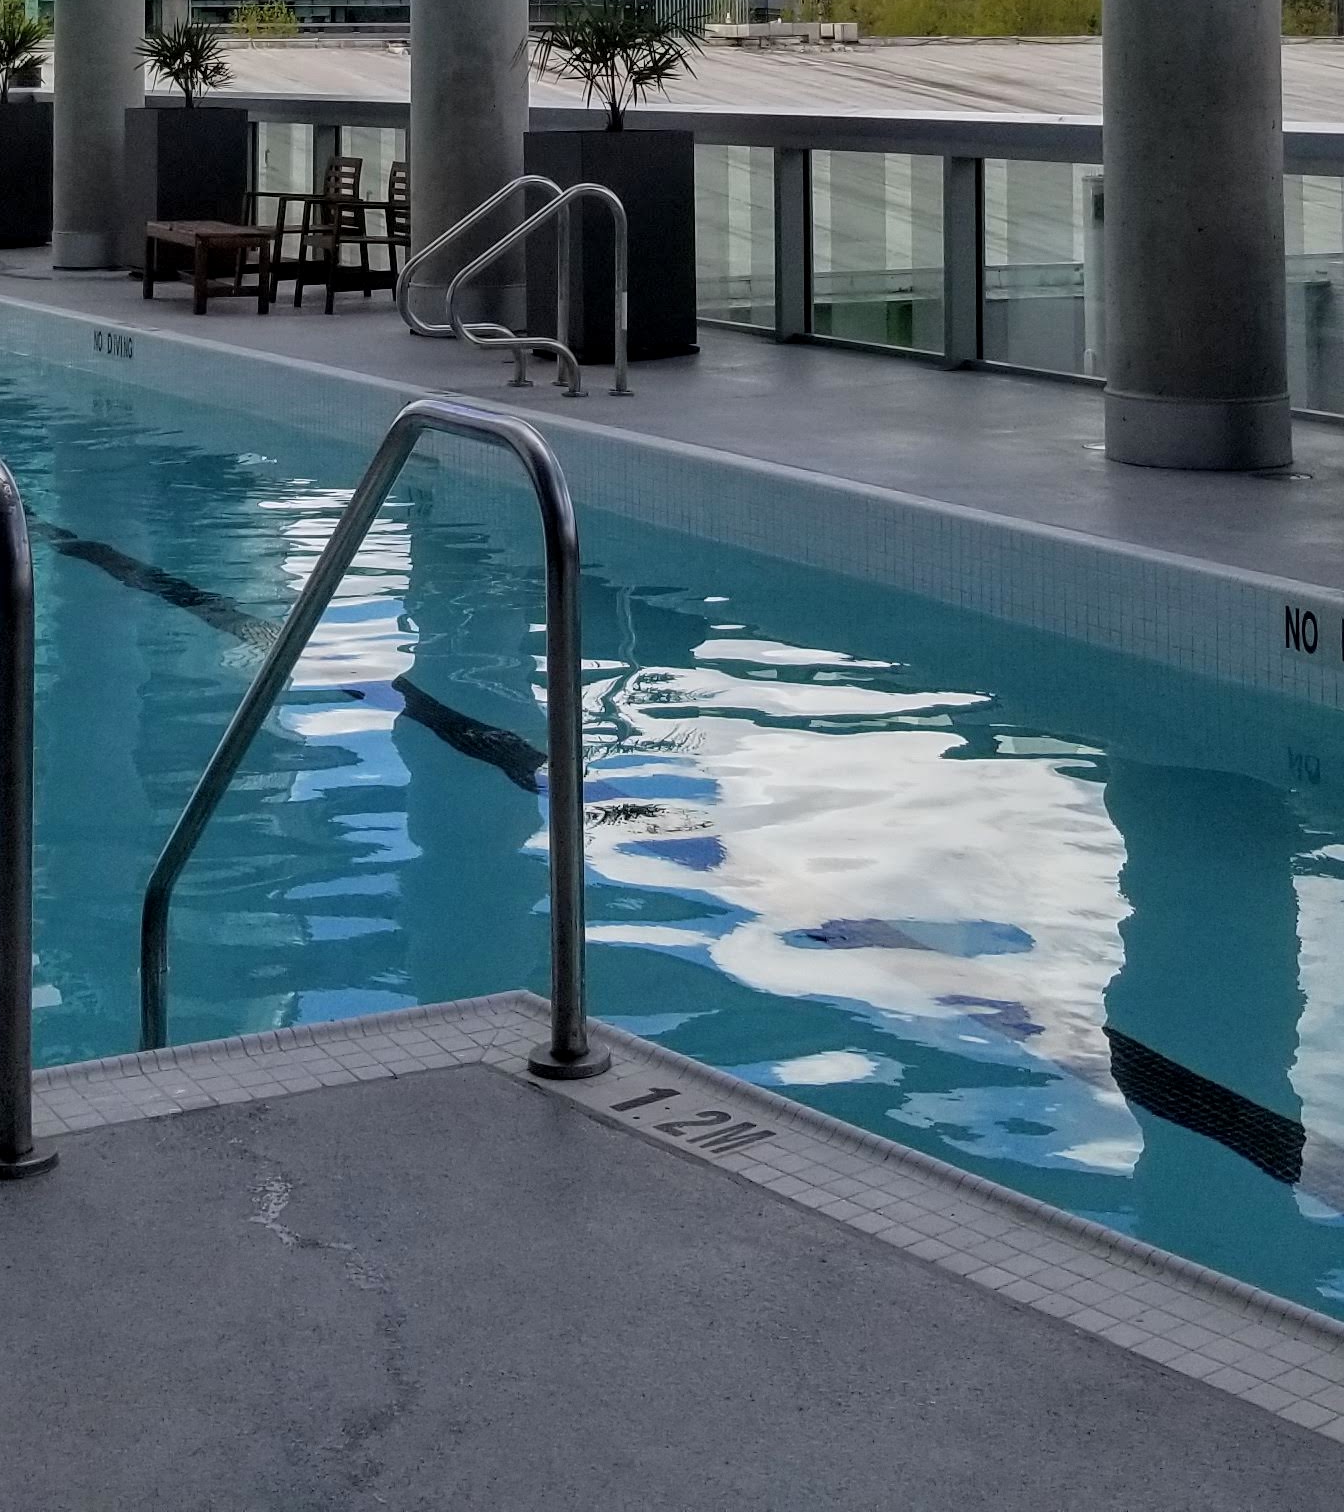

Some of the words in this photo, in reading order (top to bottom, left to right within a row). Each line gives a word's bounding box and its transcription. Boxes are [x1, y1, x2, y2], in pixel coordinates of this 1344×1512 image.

[93, 330, 103, 352] NO
[107, 332, 133, 359] DIVING
[1285, 604, 1319, 654] NO
[610, 1087, 777, 1154] 1.2M
